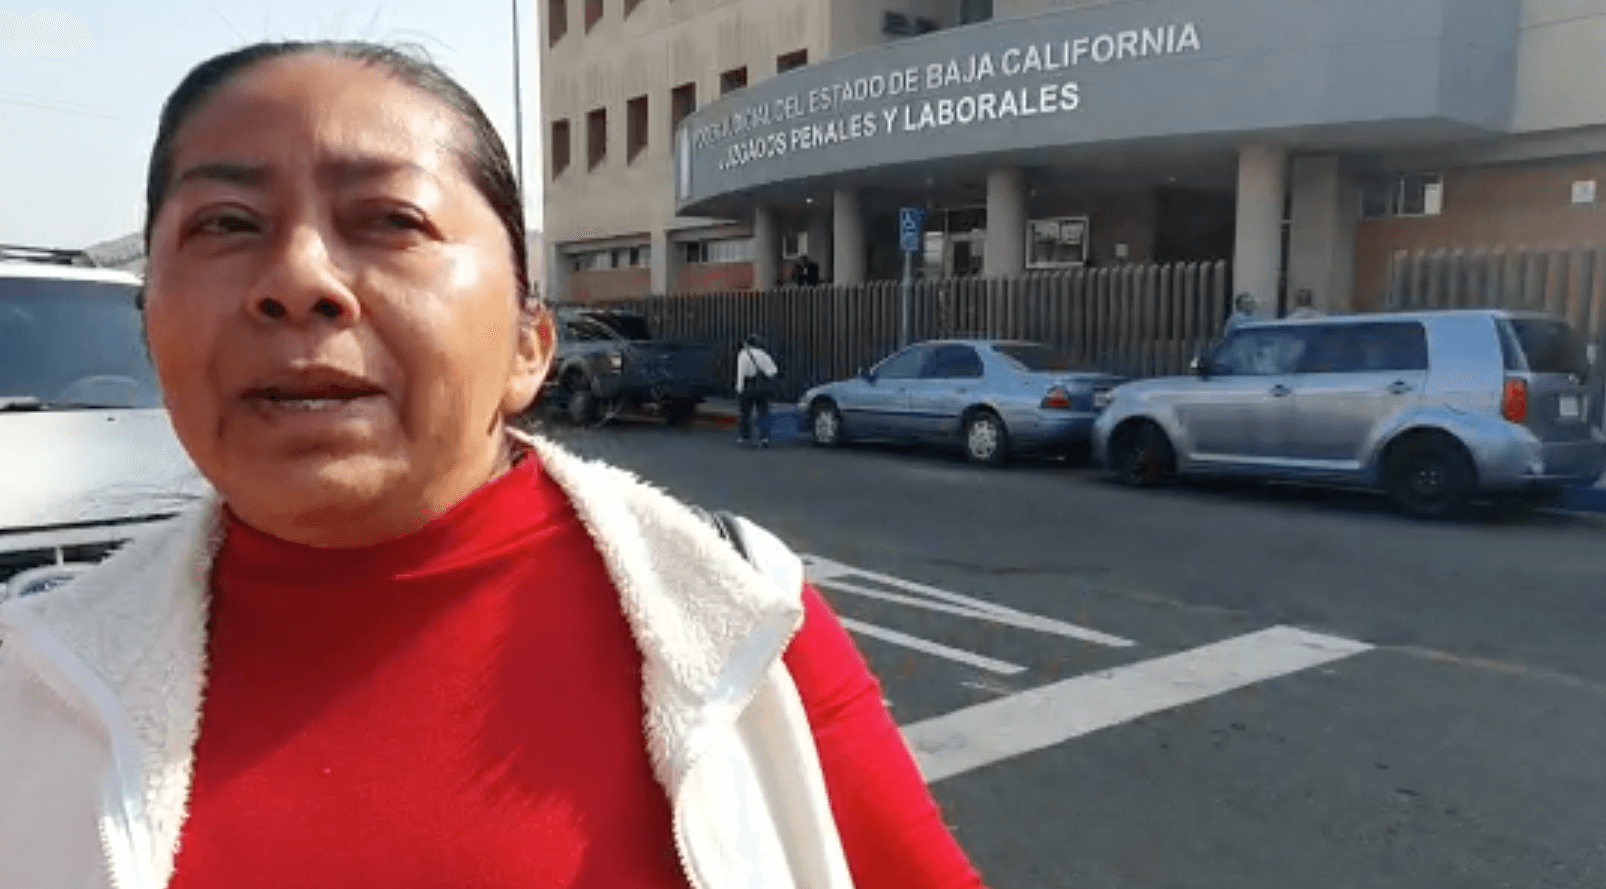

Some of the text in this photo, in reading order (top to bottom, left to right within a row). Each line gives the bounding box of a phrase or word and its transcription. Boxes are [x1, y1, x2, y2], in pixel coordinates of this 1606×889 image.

[809, 75, 884, 113] ESTADO
[890, 67, 919, 95] DE
[926, 53, 995, 89] BAJA
[1001, 21, 1200, 76] CALIFORNIA
[791, 112, 878, 151] PENALES
[883, 106, 898, 134] Y
[904, 81, 1080, 132] LABORALES
